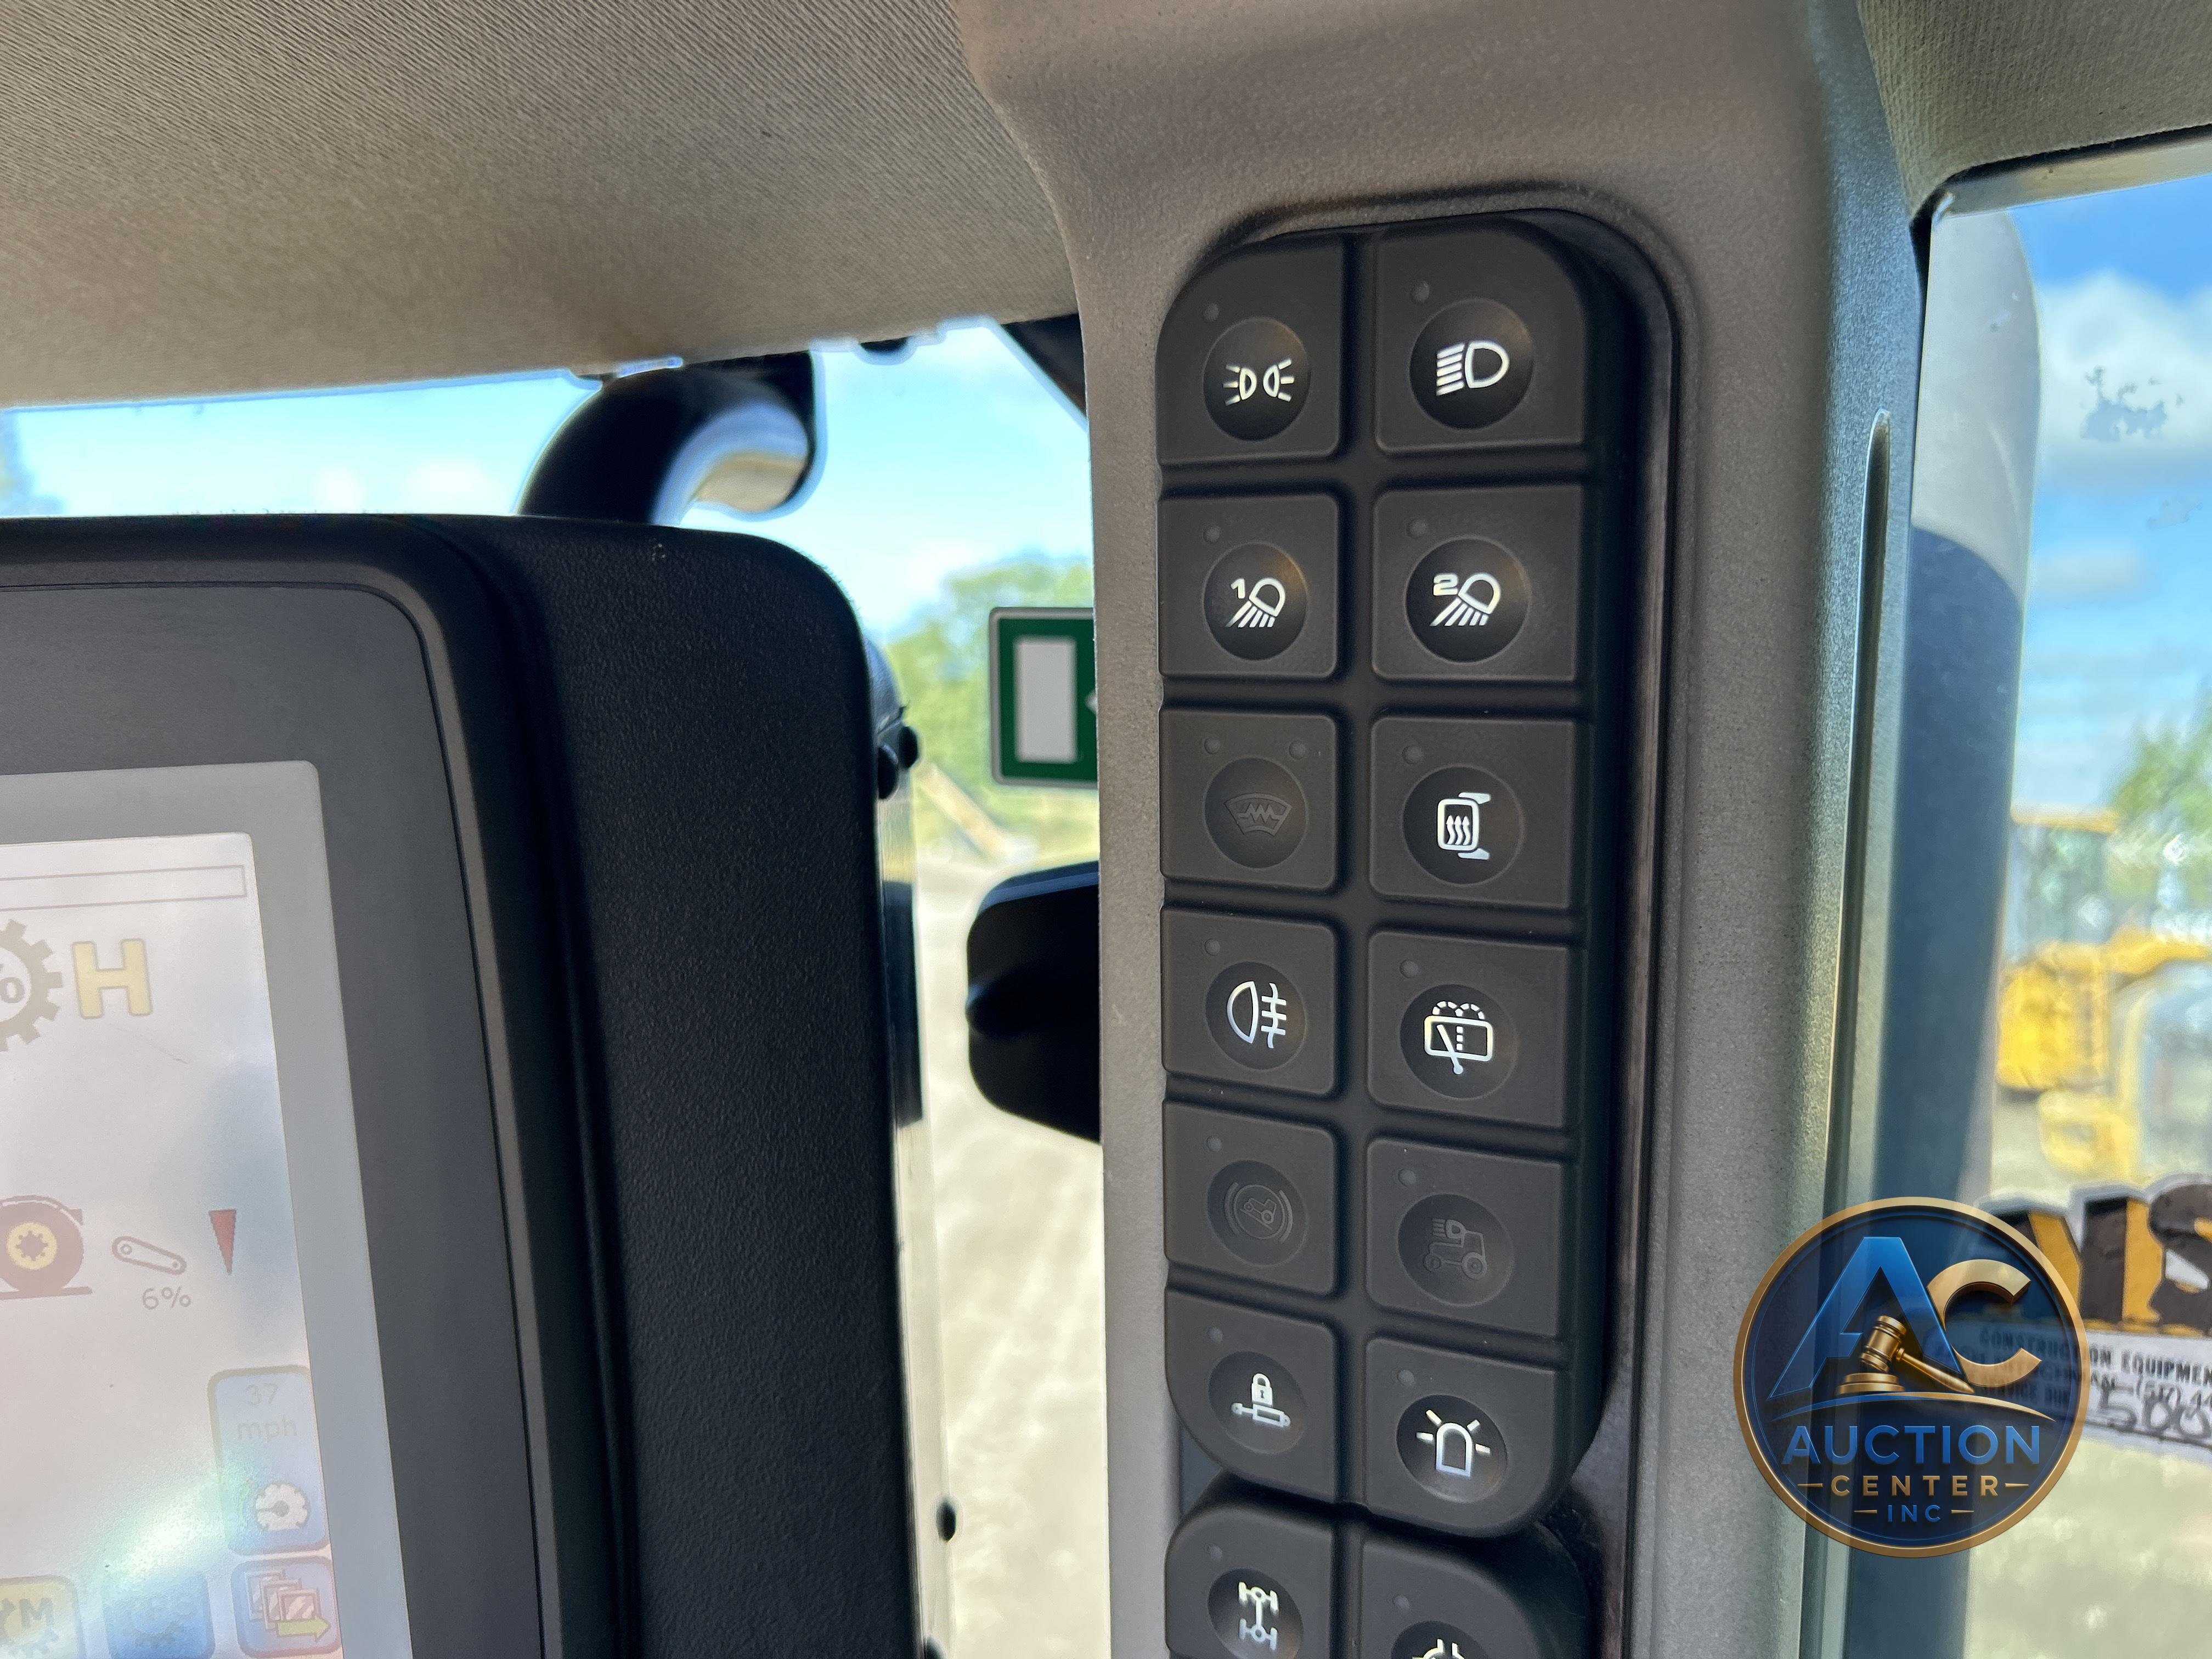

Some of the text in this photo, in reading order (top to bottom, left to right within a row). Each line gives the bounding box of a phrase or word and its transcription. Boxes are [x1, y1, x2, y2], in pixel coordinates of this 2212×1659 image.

[1230, 578, 1246, 600] 1
[1432, 573, 1459, 596] 2
[71, 938, 153, 1019] H
[142, 1285, 192, 1311] 6%
[245, 1383, 279, 1406] 37
[238, 1413, 297, 1442] mph
